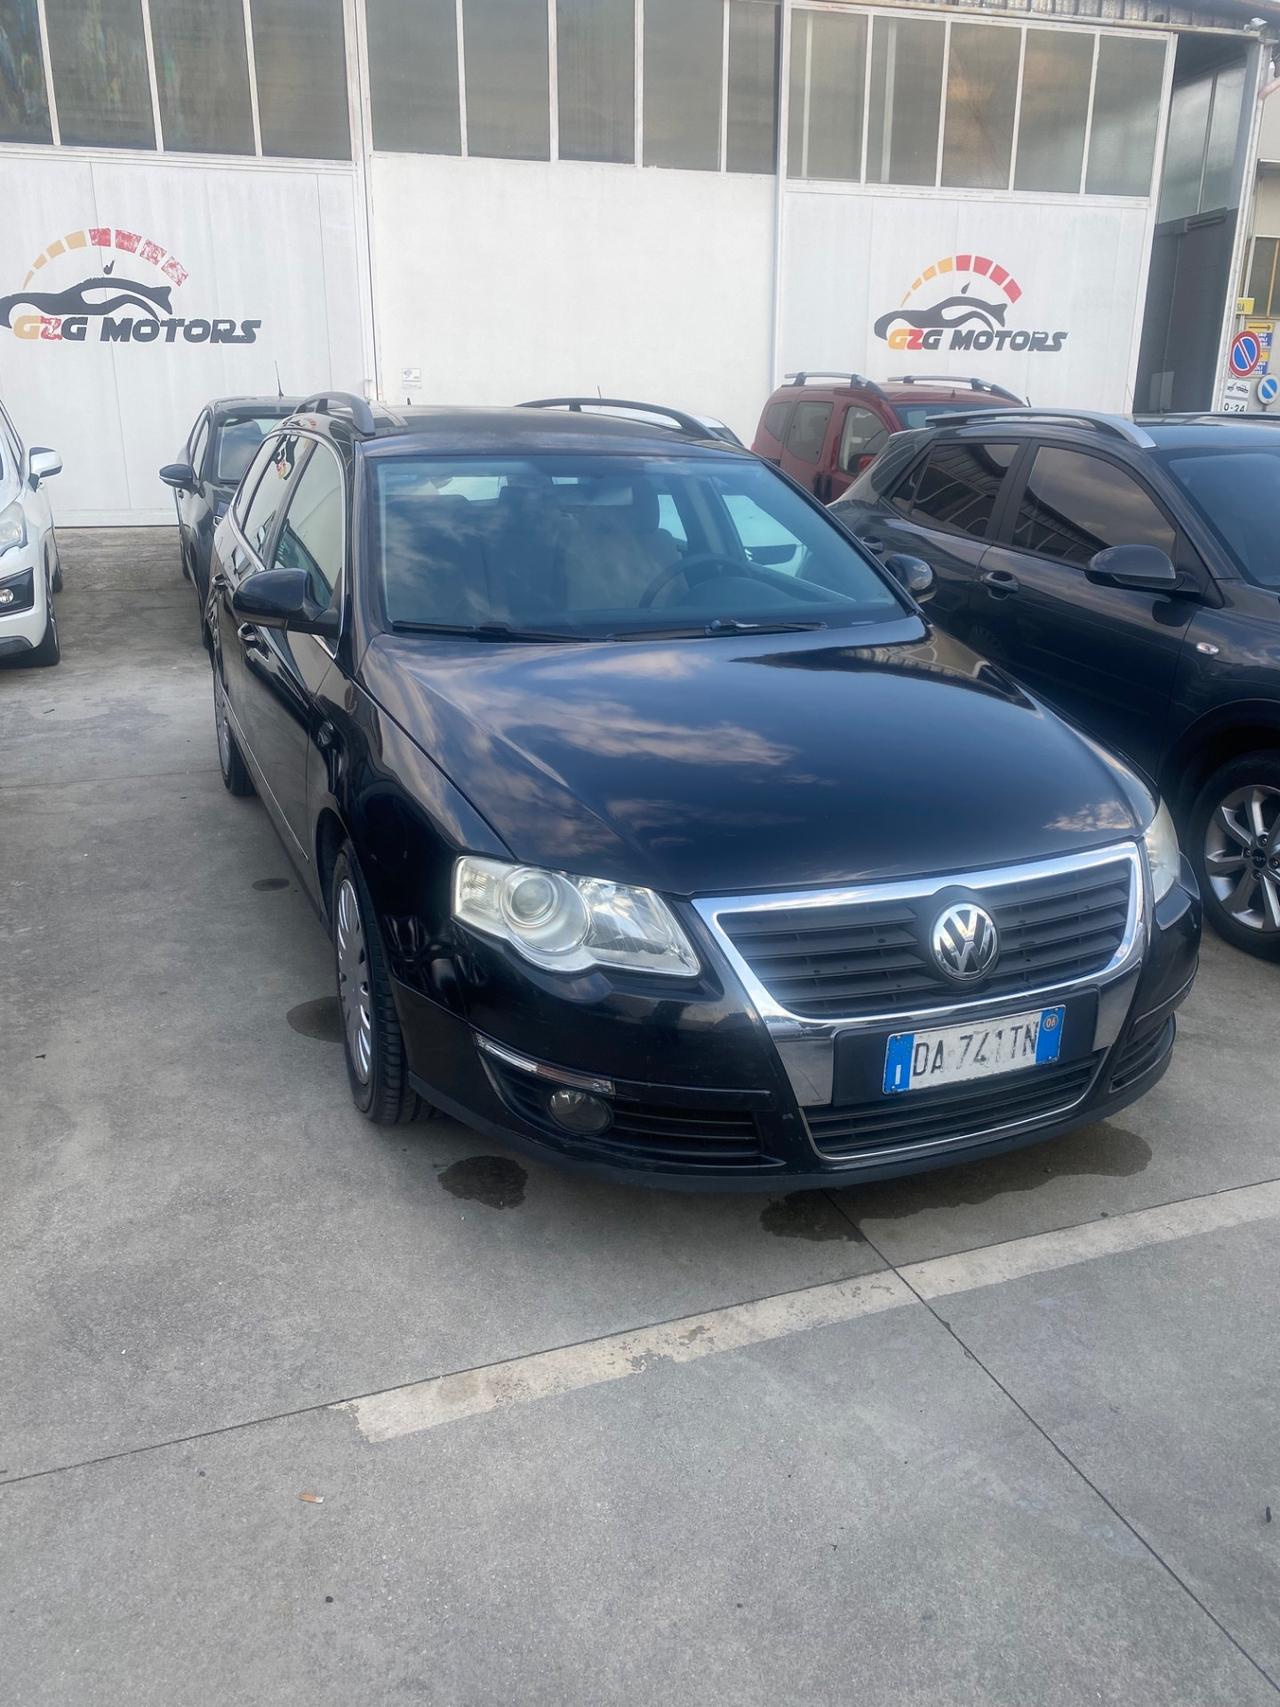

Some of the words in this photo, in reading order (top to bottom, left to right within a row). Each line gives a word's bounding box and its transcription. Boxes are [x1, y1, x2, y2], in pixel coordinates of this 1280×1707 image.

[14, 315, 89, 341] GZG
[100, 317, 261, 343] MOTORS
[888, 328, 943, 350] GZG
[949, 330, 1068, 352] MOTORS
[912, 1040, 944, 1077] DA
